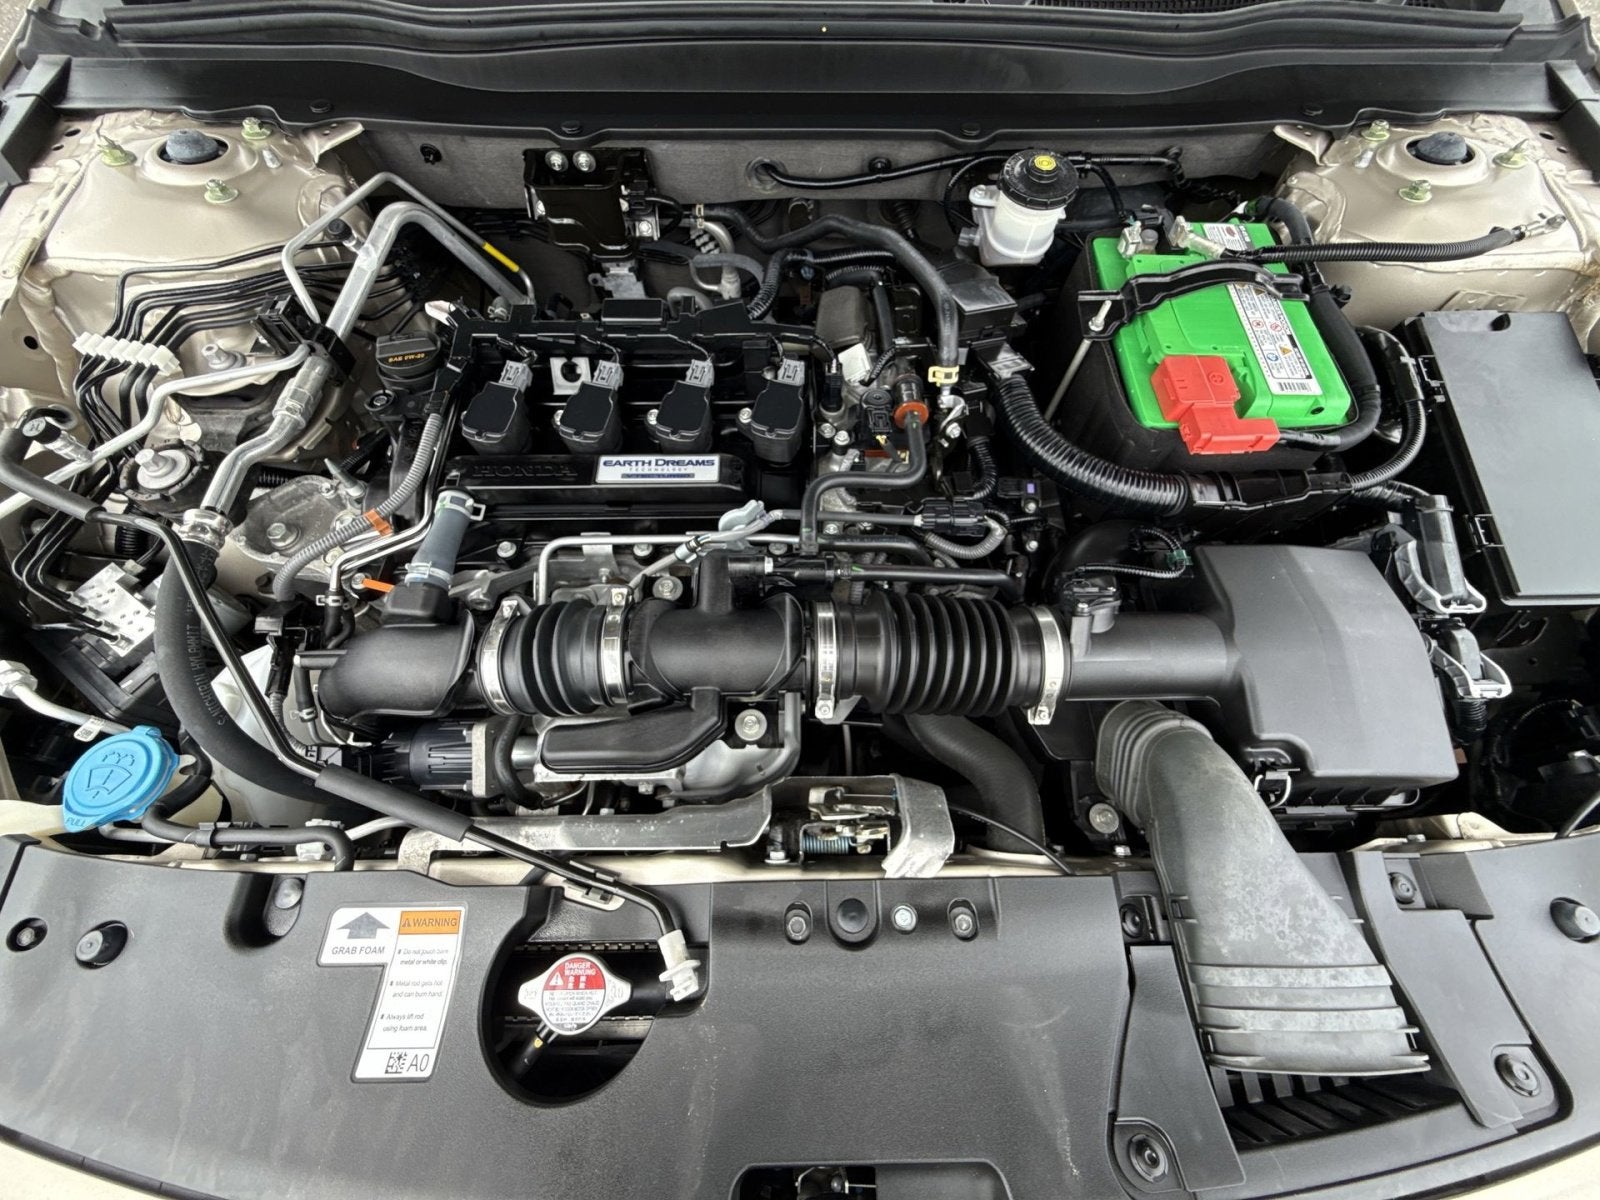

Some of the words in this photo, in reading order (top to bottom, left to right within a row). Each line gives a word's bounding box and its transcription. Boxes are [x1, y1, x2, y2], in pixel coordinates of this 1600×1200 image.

[603, 459, 651, 467] EARTH
[655, 458, 715, 467] DREAMS
[413, 917, 457, 927] WARNING
[331, 947, 357, 955] GRAB
[359, 946, 385, 955] FOAM
[406, 1054, 430, 1072] A0
